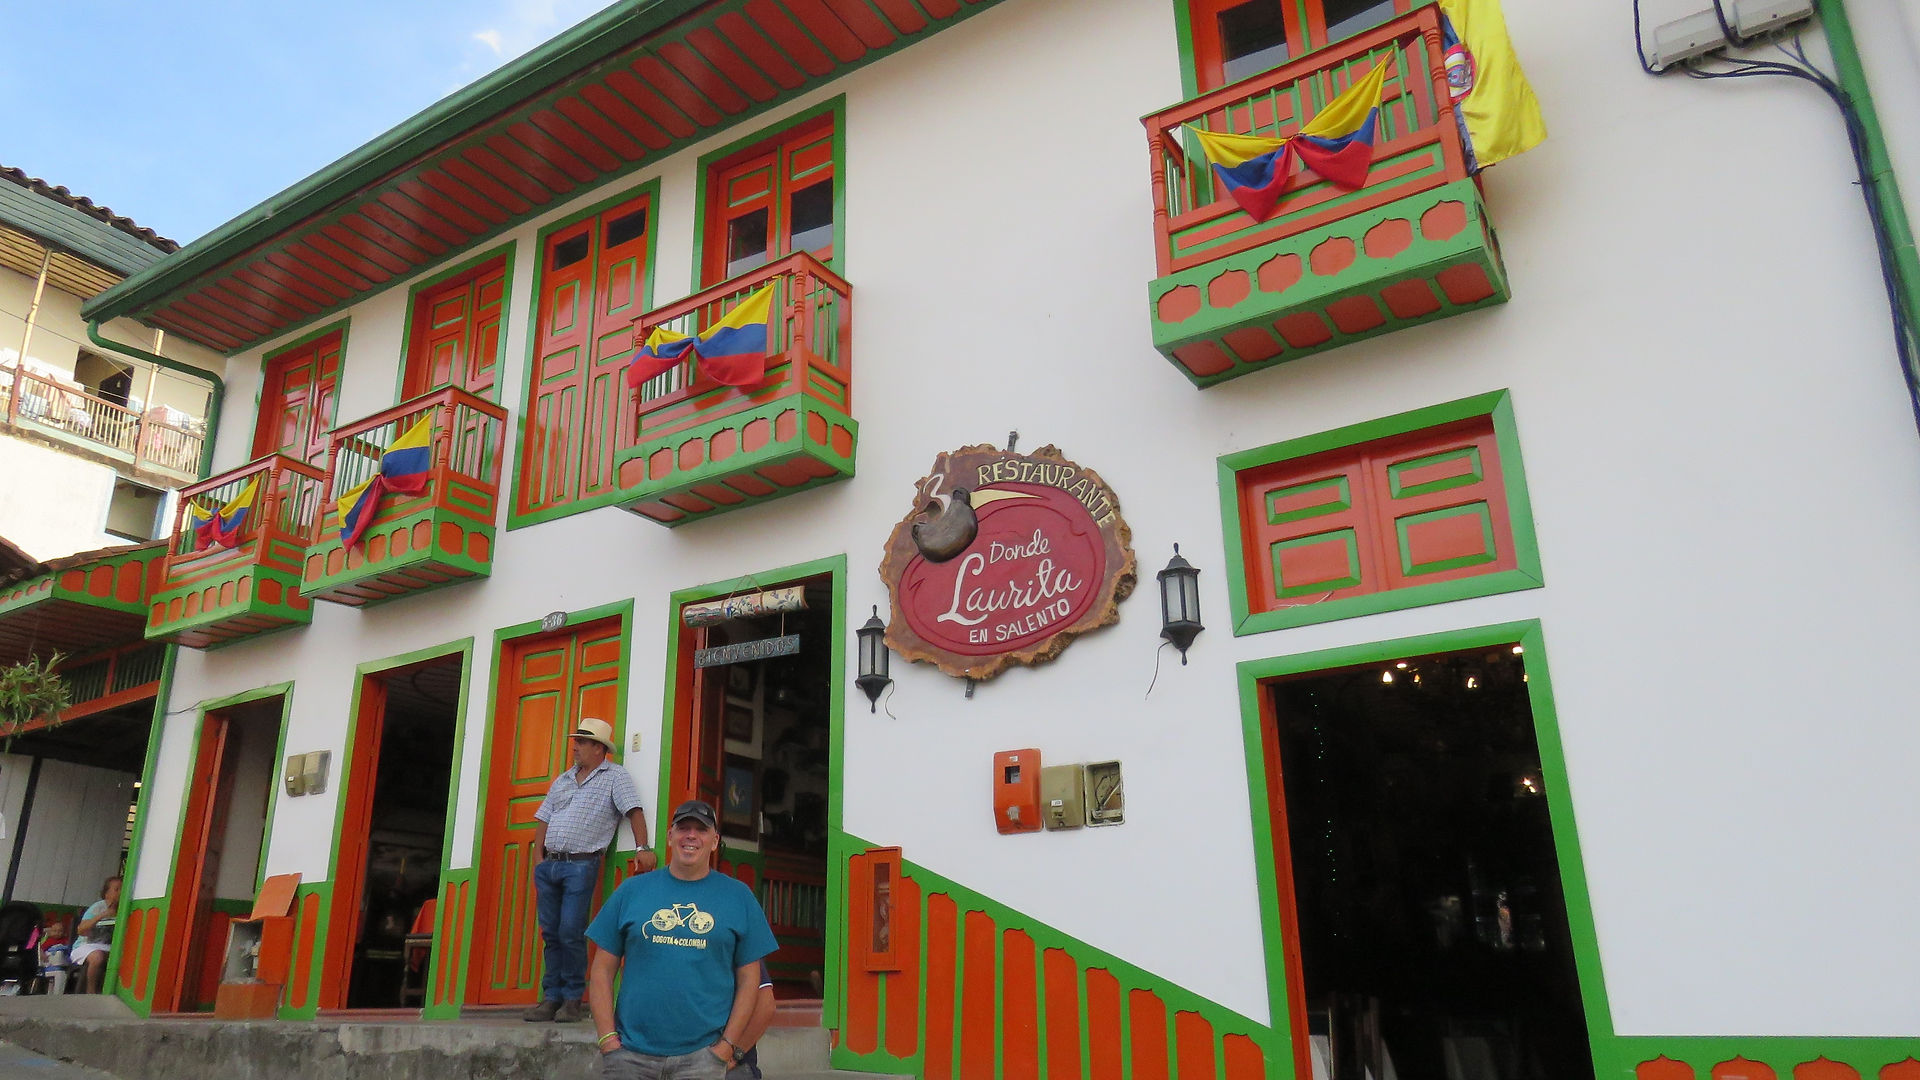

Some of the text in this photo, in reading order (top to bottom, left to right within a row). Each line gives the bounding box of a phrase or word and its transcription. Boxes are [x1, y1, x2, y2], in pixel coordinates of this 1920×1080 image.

[976, 459, 1117, 529] RESTAURANTE
[989, 528, 1051, 564] Donde
[937, 552, 1082, 626] Laurita
[969, 598, 1071, 644] EN SALENTO
[698, 637, 796, 667] BIENVENIDOS
[679, 938, 706, 949] COLOMBIA
